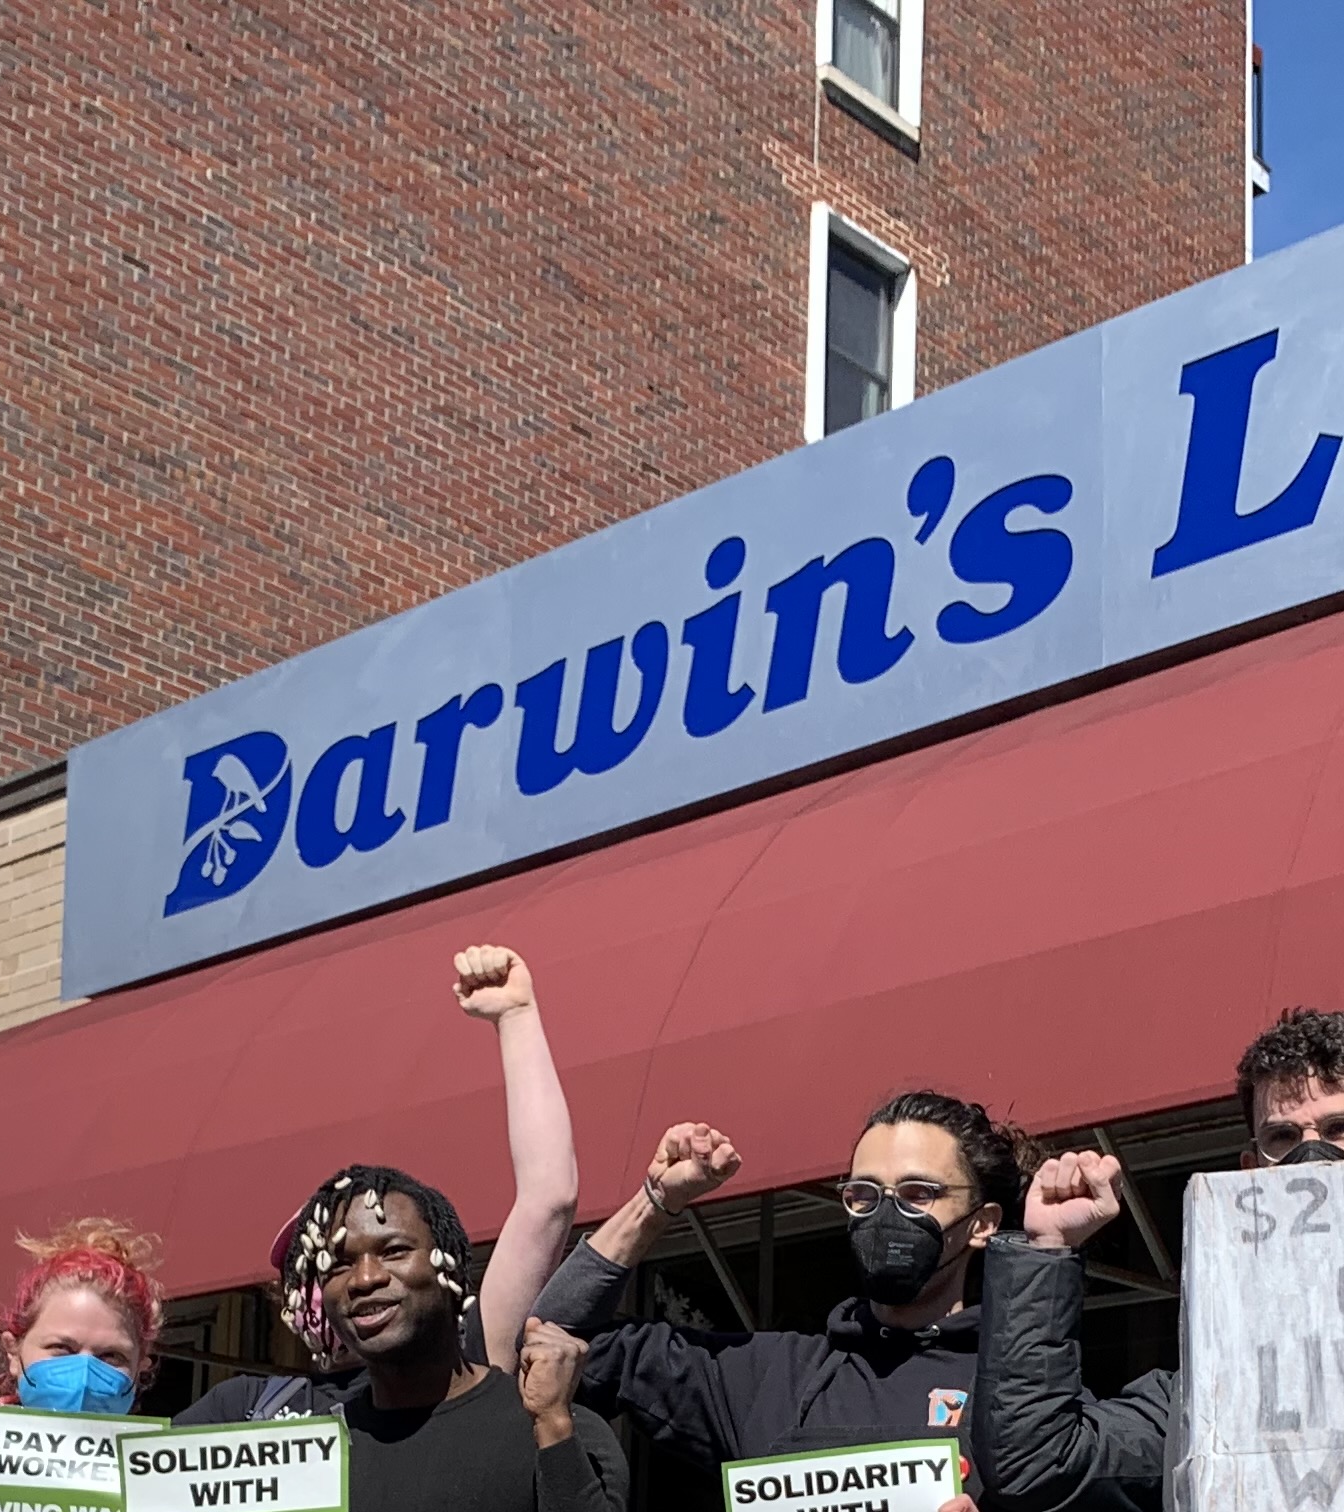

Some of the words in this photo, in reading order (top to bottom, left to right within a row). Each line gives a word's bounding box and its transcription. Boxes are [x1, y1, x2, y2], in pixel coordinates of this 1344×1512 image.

[164, 454, 1075, 919] Darwin's
[3, 1430, 67, 1454] PAY
[74, 1436, 116, 1458] CA
[128, 1435, 337, 1476] SOLIDARITY
[189, 1477, 279, 1507] WITH
[734, 1457, 949, 1504] SOLIDARITY
